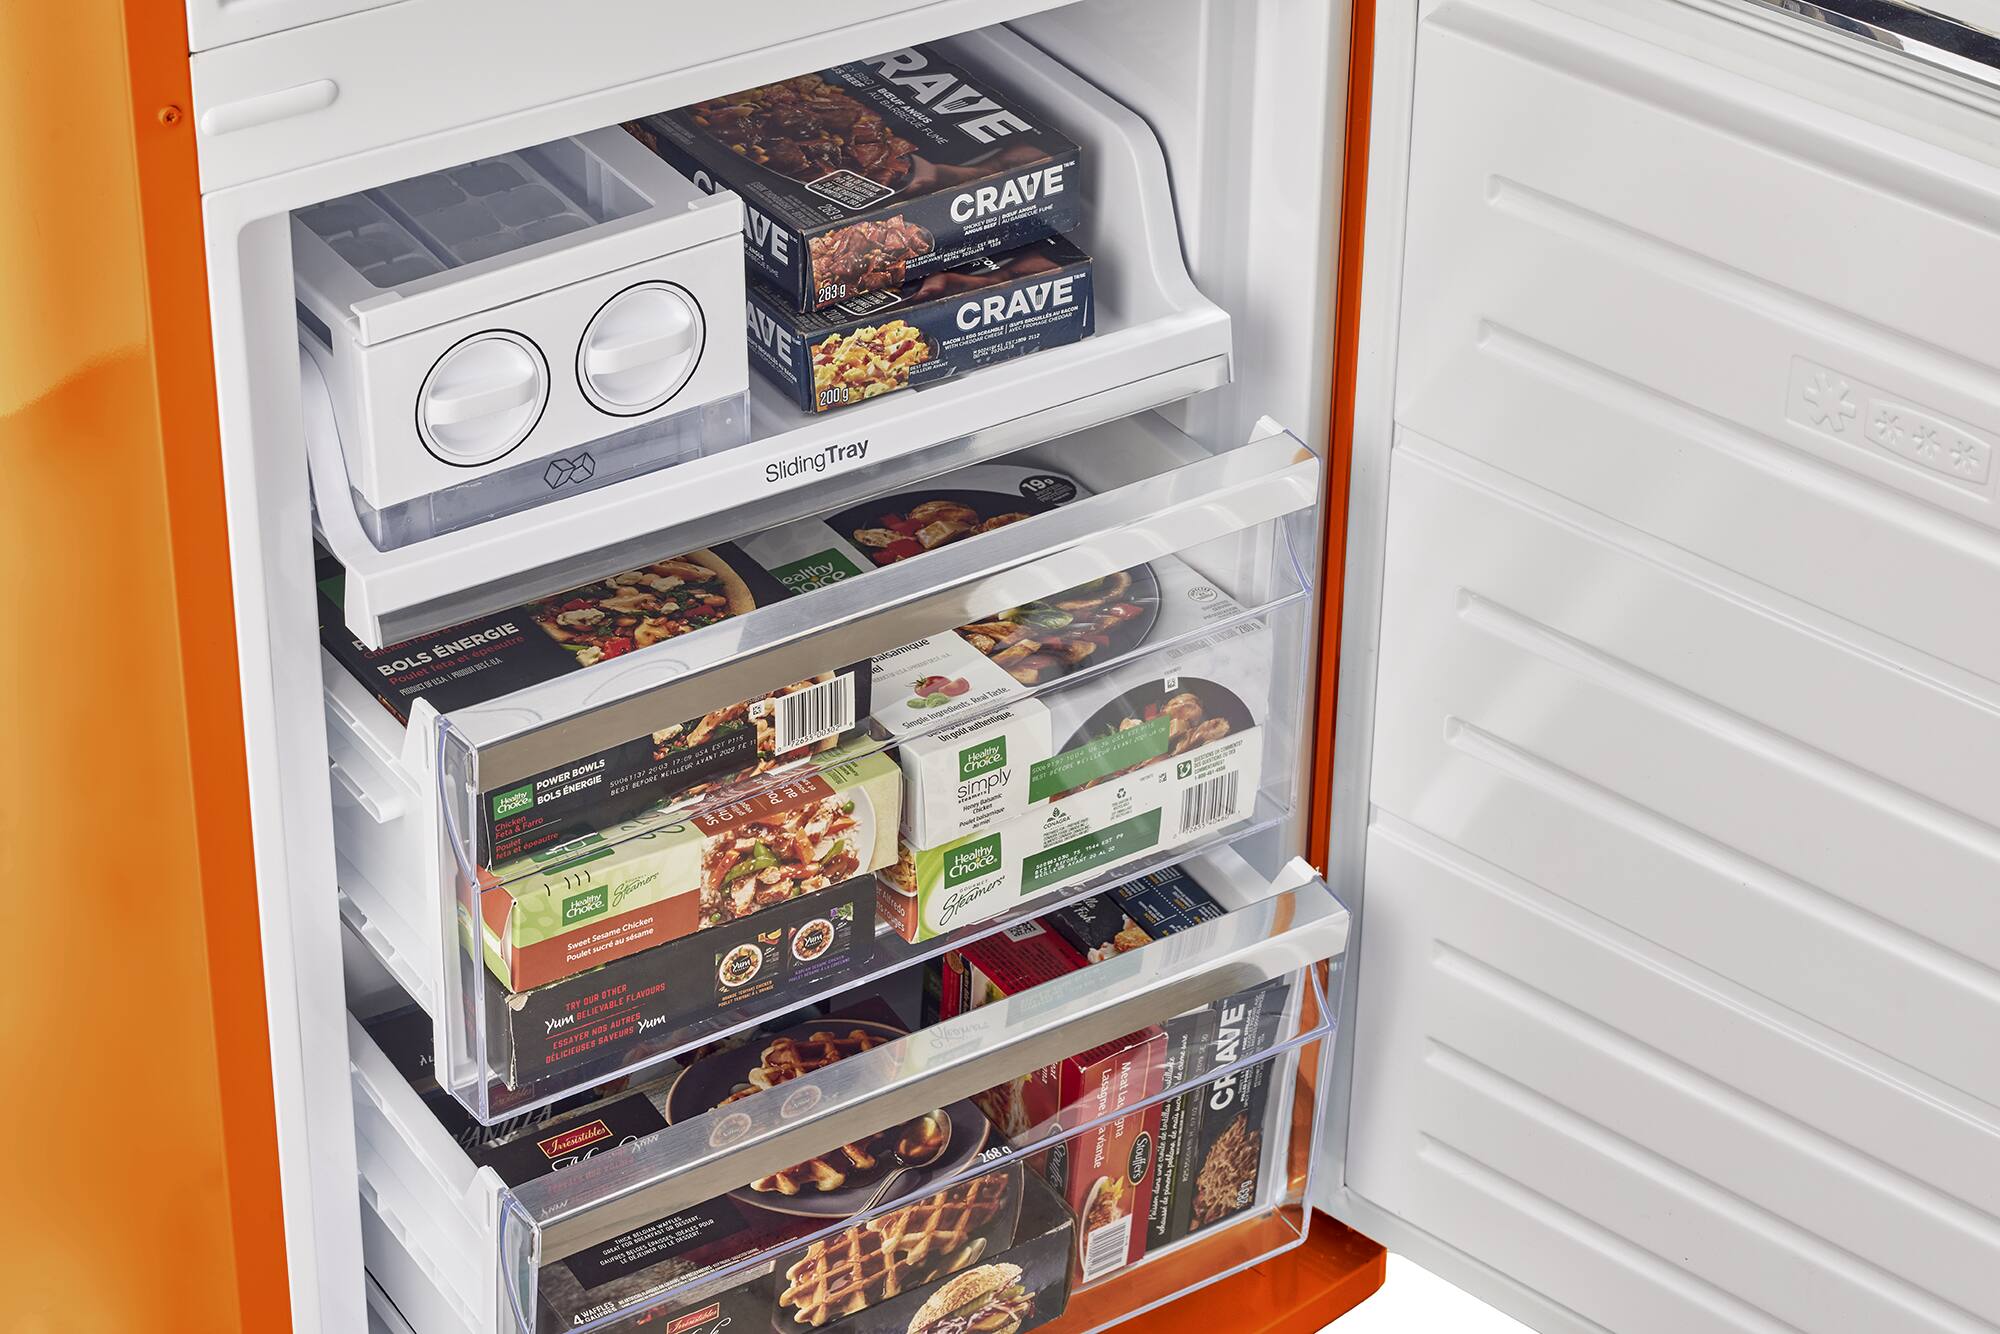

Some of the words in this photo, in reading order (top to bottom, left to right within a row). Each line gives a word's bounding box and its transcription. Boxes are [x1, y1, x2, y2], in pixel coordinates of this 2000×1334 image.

[862, 46, 1033, 144] RAVE
[900, 105, 933, 124] ANGUS
[951, 165, 1064, 223] CRAVE
[817, 285, 838, 304] 283
[956, 276, 1074, 330] CRAVE
[1060, 305, 1079, 315] BACON
[746, 299, 793, 367] AVE
[942, 336, 961, 347] BACON
[965, 332, 977, 341] EGG
[977, 325, 1004, 337] SCRAMBLE
[1008, 325, 1023, 333] AVEC
[1022, 319, 1048, 329] FROMAGE
[944, 342, 959, 351] WITH
[958, 336, 984, 348] CHEDDAR
[984, 331, 1003, 341] CHEESE
[820, 388, 840, 406] 200
[766, 439, 869, 483] SlidingTray
[779, 561, 834, 585] ealthy
[376, 652, 433, 677] BOLS
[431, 622, 520, 658] ÉNERGIE
[388, 667, 430, 686] Poulet
[430, 660, 456, 672] feta
[457, 654, 470, 664] et
[471, 635, 526, 657] épeautre
[902, 714, 929, 730] Simple
[711, 741, 726, 752] EST
[937, 732, 951, 743] Un
[963, 752, 1001, 773] Choice
[967, 745, 1000, 762] Healthy
[536, 771, 571, 791] POWER
[571, 758, 606, 775] BOWLS
[609, 784, 630, 797] BEST
[631, 774, 659, 789] BEFORE
[660, 761, 694, 780] MEILLEUR
[694, 752, 719, 768] AVANT
[957, 768, 1012, 799] simply
[500, 791, 528, 807] Healthy
[537, 790, 562, 805] BOLS
[562, 774, 603, 796] ÉNERGIE
[497, 797, 529, 815] Choice
[962, 801, 980, 813] Honey
[979, 793, 1003, 806] Balsamic
[972, 802, 993, 815] Chicken
[495, 814, 527, 833] Chicken
[495, 827, 514, 840] Feta
[521, 816, 545, 832] Farro
[959, 816, 977, 828] Poulet
[975, 806, 1006, 822] balsamique
[1043, 815, 1071, 830] CONAGRA
[495, 837, 522, 852] Poulet
[495, 848, 512, 861] feta
[513, 845, 522, 855] et
[523, 831, 560, 851] épeautre
[954, 845, 994, 866] Healthy
[949, 854, 995, 878] Choice
[570, 893, 602, 909] Healthy
[611, 874, 656, 908] Steamers
[939, 878, 1003, 927] Steamers
[566, 900, 603, 919] Choice
[566, 947, 592, 963] Poulet
[592, 940, 614, 954] sucré
[614, 937, 625, 947] au
[625, 926, 655, 943] sésame
[567, 935, 591, 951] Sweet
[592, 926, 621, 943] Sesame
[621, 916, 655, 932] Chicken
[565, 999, 582, 1012] TRY
[583, 992, 599, 1007] OUR
[601, 983, 628, 1001] OTHER
[576, 996, 625, 1021] BELIEVABLE
[625, 981, 667, 1004] FLAVOURS
[552, 1030, 590, 1050] ESSAYER
[590, 1023, 608, 1037] NOS
[609, 1011, 641, 1030] AUTRES
[545, 1038, 596, 1065] DÉLICIEUSES
[597, 1025, 635, 1046] SAVEURS
[1119, 1060, 1132, 1091] Meat
[1159, 1103, 1171, 1131] tortillas
[1158, 1129, 1168, 1141] de
[1167, 1128, 1177, 1140] de
[977, 1147, 1003, 1164] 268
[1093, 1138, 1106, 1169] viande
[1131, 1136, 1149, 1180] Stouffer's
[1151, 1178, 1161, 1195] dans
[1163, 1168, 1173, 1196] piments
[1148, 1195, 1160, 1221] Poisson
[1159, 1194, 1169, 1206] de
[599, 1252, 627, 1267] GAUFRES
[627, 1244, 648, 1257] BELGES
[698, 1218, 715, 1229] POUR
[602, 1244, 621, 1256] GREAT
[621, 1239, 634, 1249] FOR
[634, 1228, 665, 1244] BREAKFAST
[614, 1235, 633, 1246] THICK
[632, 1225, 657, 1239] BELGIAN
[656, 1215, 683, 1230] WAFFLES
[619, 1257, 628, 1266] LE
[657, 1243, 667, 1251] OU
[667, 1238, 676, 1247] LE
[573, 1314, 585, 1326] 4
[580, 1300, 615, 1317] WAFFLES
